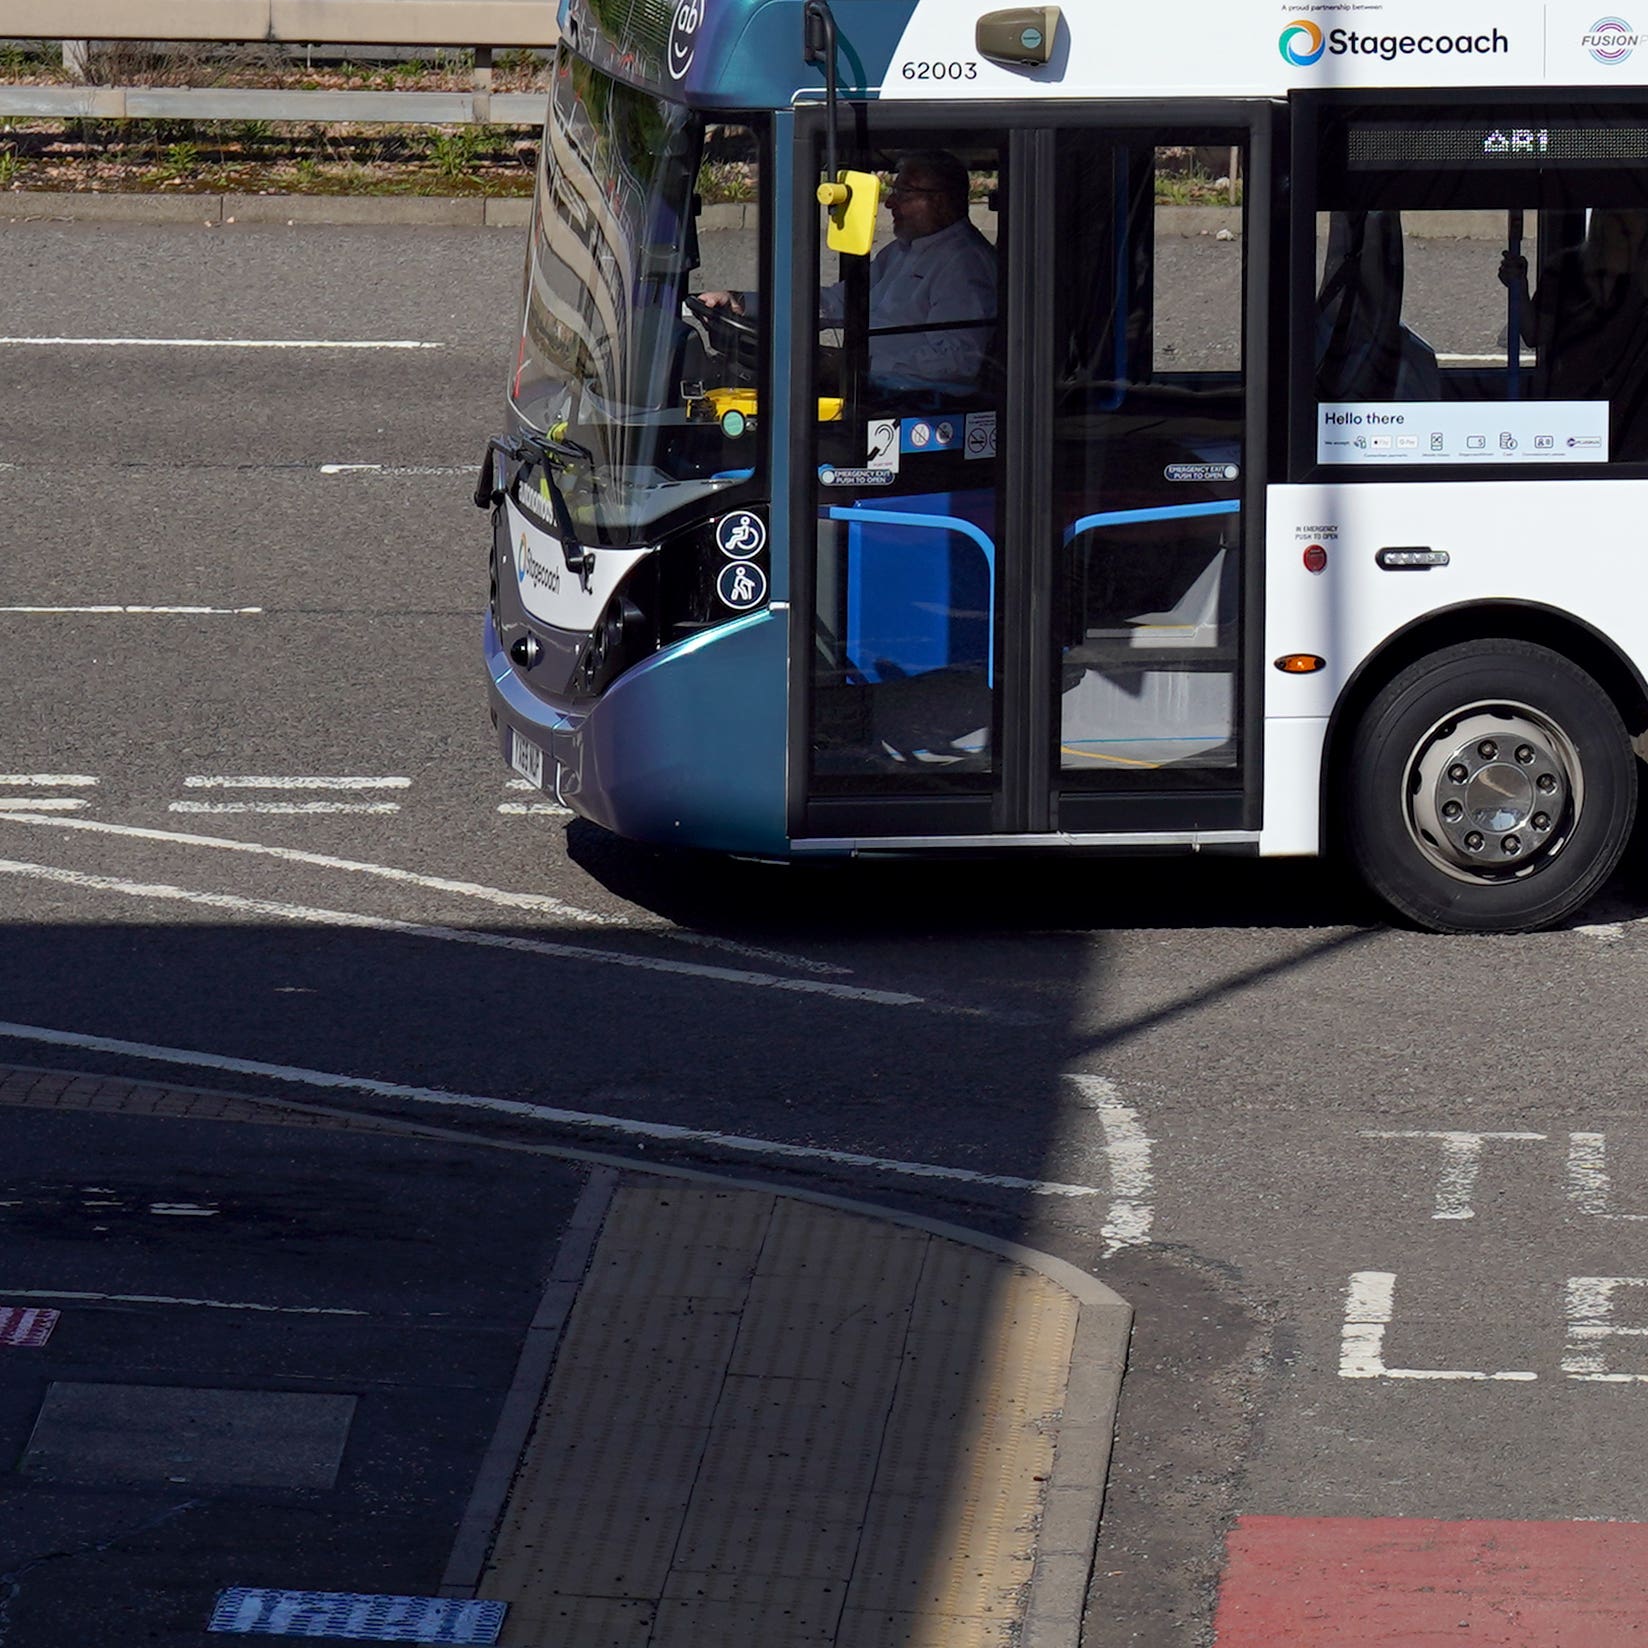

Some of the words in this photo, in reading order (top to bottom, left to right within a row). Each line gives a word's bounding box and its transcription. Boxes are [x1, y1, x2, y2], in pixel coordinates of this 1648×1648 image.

[1311, 4, 1351, 12] partnership
[1329, 28, 1508, 61] Stagecoach
[902, 62, 977, 80] 62003
[1325, 412, 1362, 425] Hello
[1367, 413, 1404, 425] there
